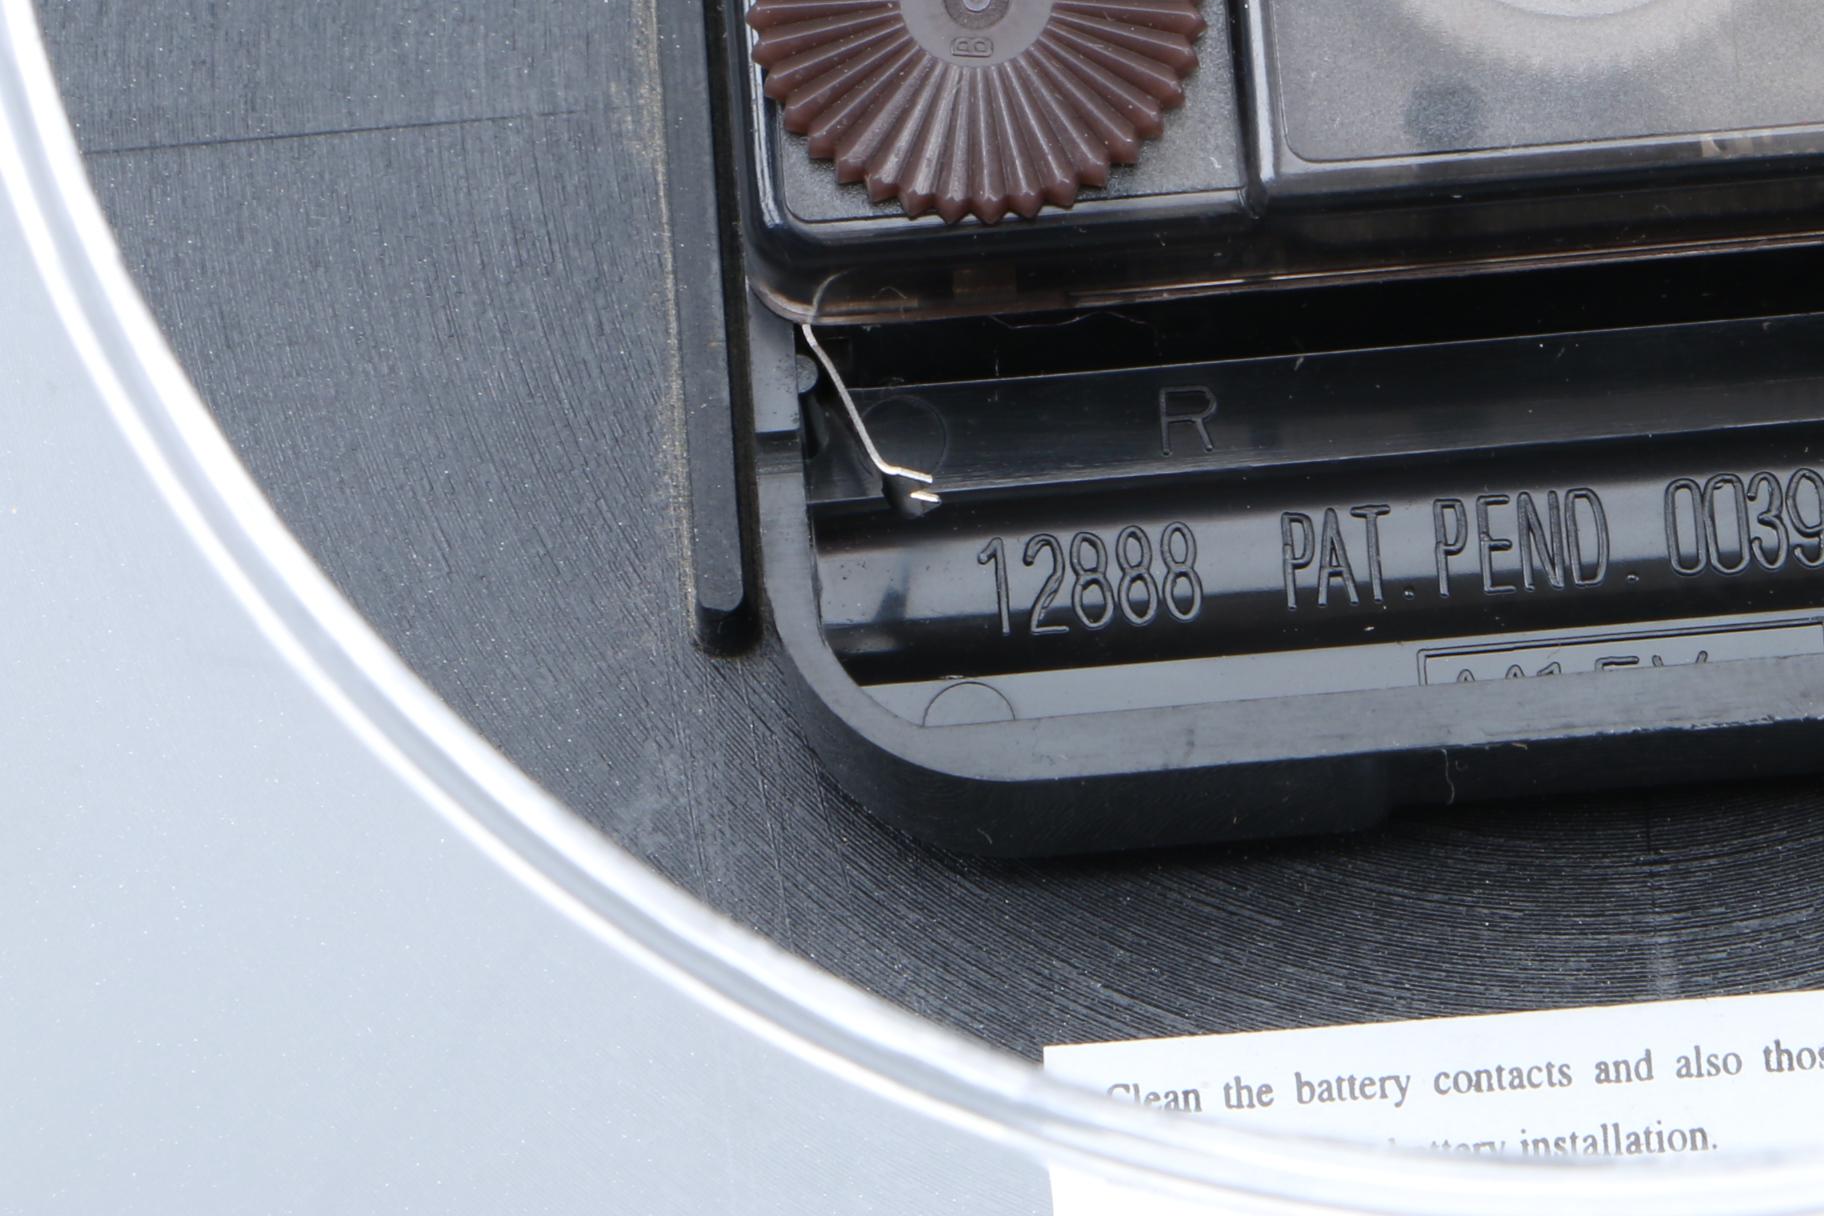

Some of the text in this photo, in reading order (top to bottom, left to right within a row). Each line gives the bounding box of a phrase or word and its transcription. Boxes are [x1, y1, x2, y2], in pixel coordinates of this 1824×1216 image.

[1158, 385, 1217, 456] R
[976, 520, 1204, 636] 12888
[1280, 503, 1417, 610] PAT.
[1431, 486, 1640, 598] PEND.
[1223, 1076, 1275, 1110] the
[1294, 1071, 1412, 1107] battery
[1433, 1056, 1574, 1096] contacts
[1594, 1048, 1654, 1085] and
[1675, 1045, 1743, 1079] also
[1519, 1120, 1718, 1158] installation.
